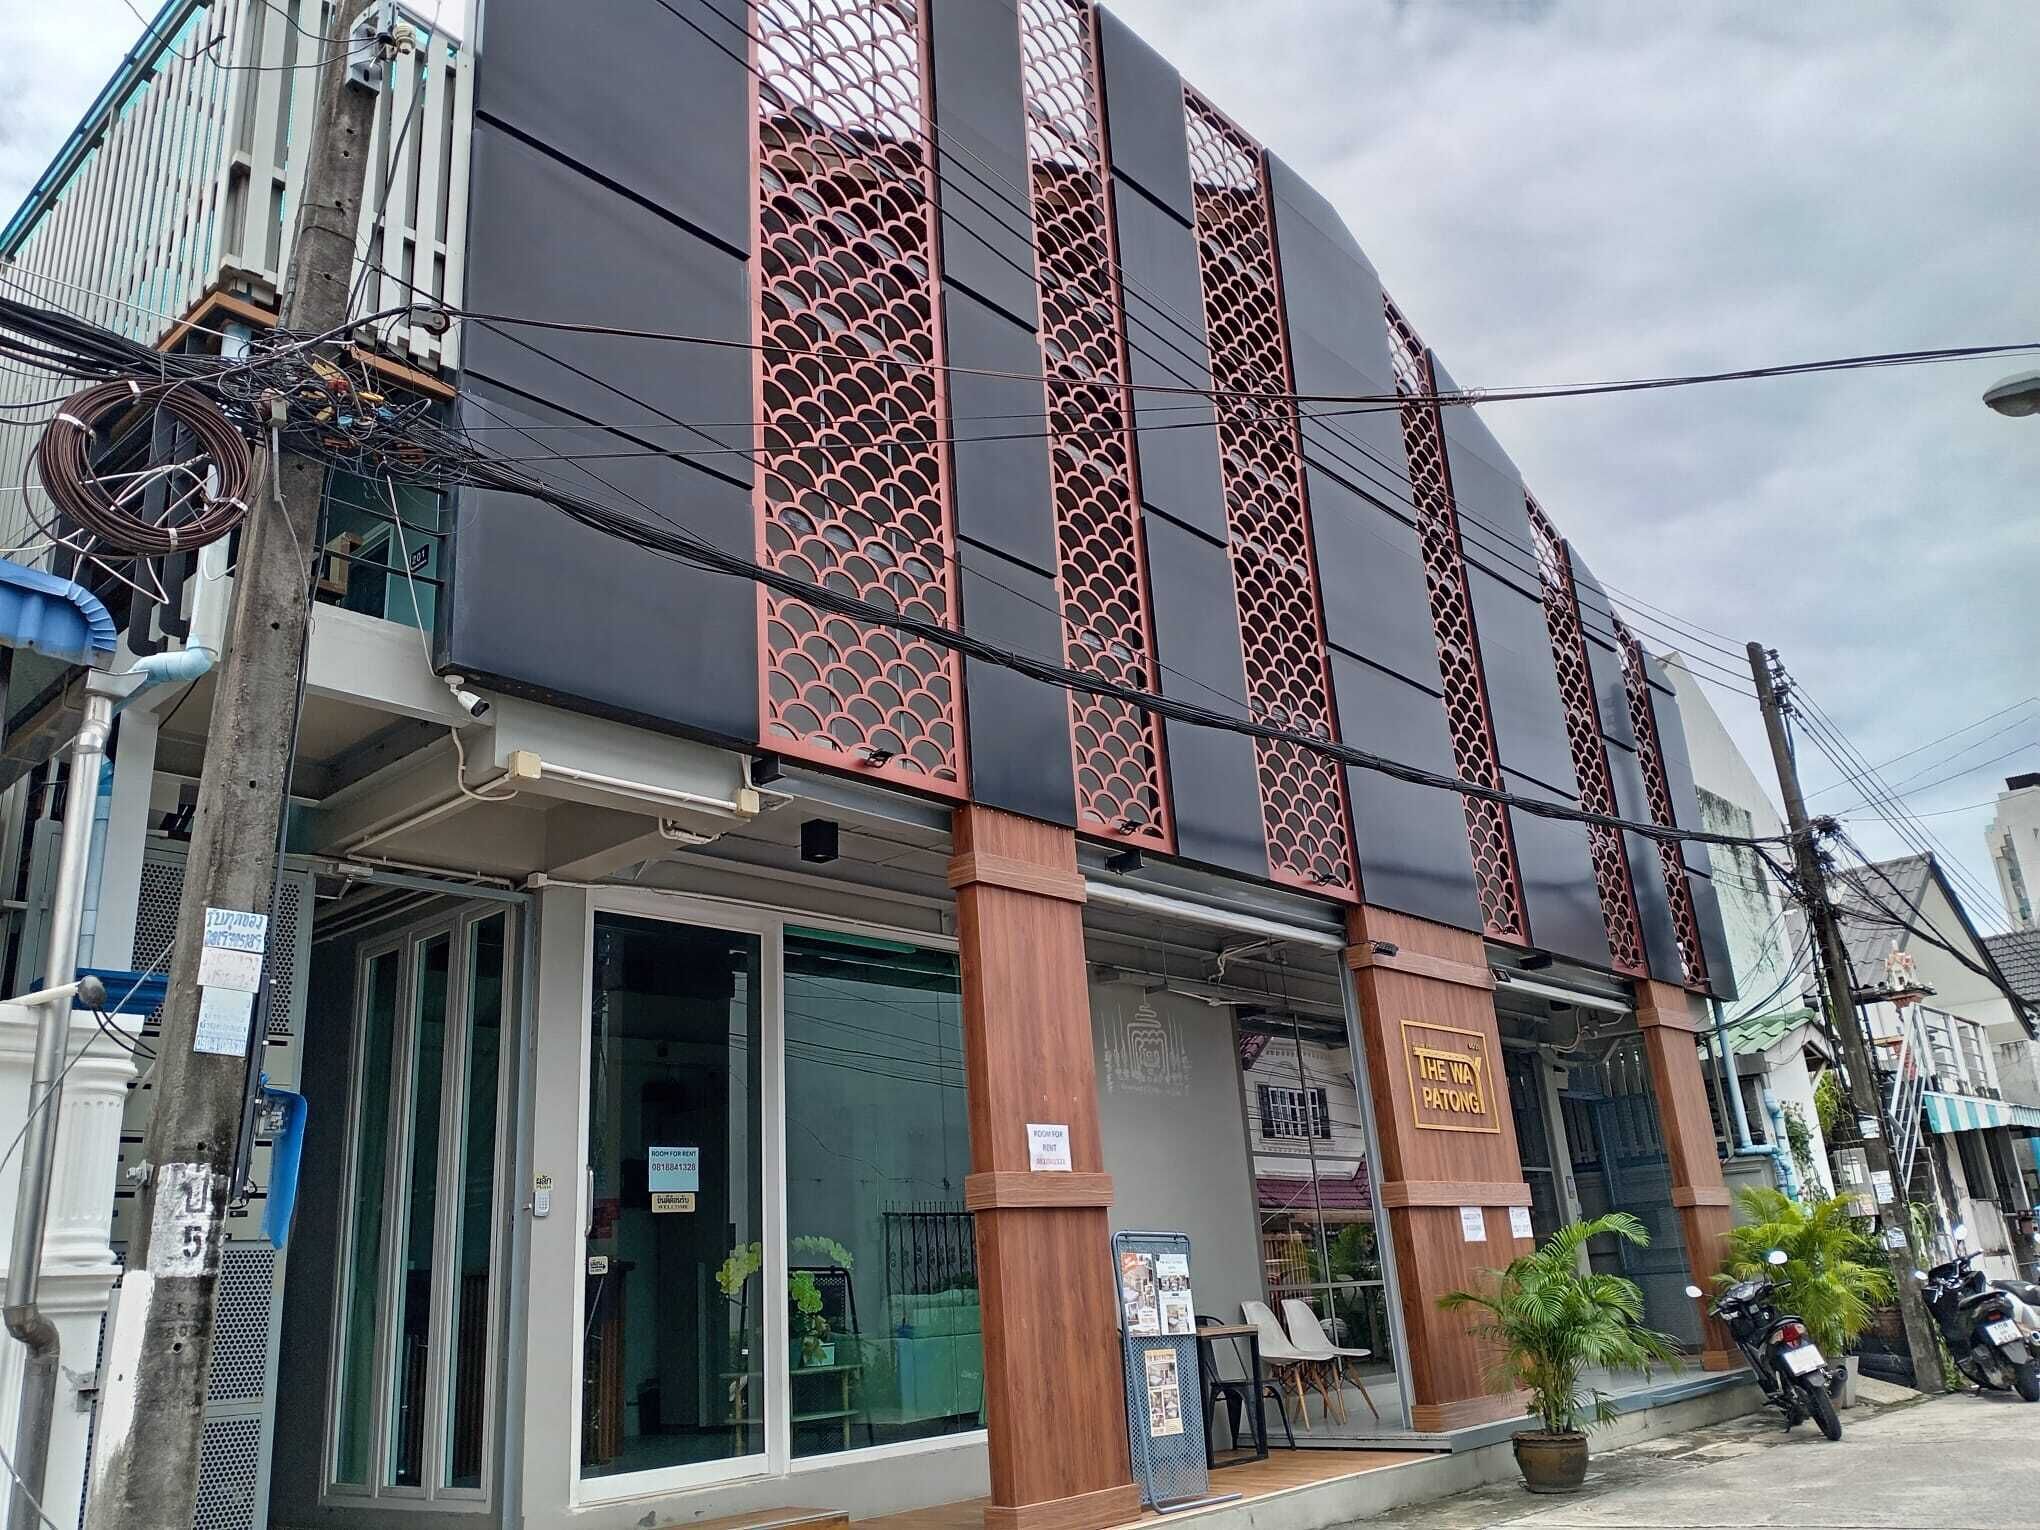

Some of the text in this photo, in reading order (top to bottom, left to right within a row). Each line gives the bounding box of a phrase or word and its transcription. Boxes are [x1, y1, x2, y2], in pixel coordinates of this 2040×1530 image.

[411, 549, 426, 566] 201
[1413, 1046, 1486, 1114] THE WAY
[1422, 1087, 1480, 1114] PATONG
[1033, 1130, 1063, 1138] ROOM FOR
[652, 1150, 696, 1158] ROOM FOR RENT
[1042, 1143, 1057, 1152] RENT
[183, 1226, 202, 1258] 5
